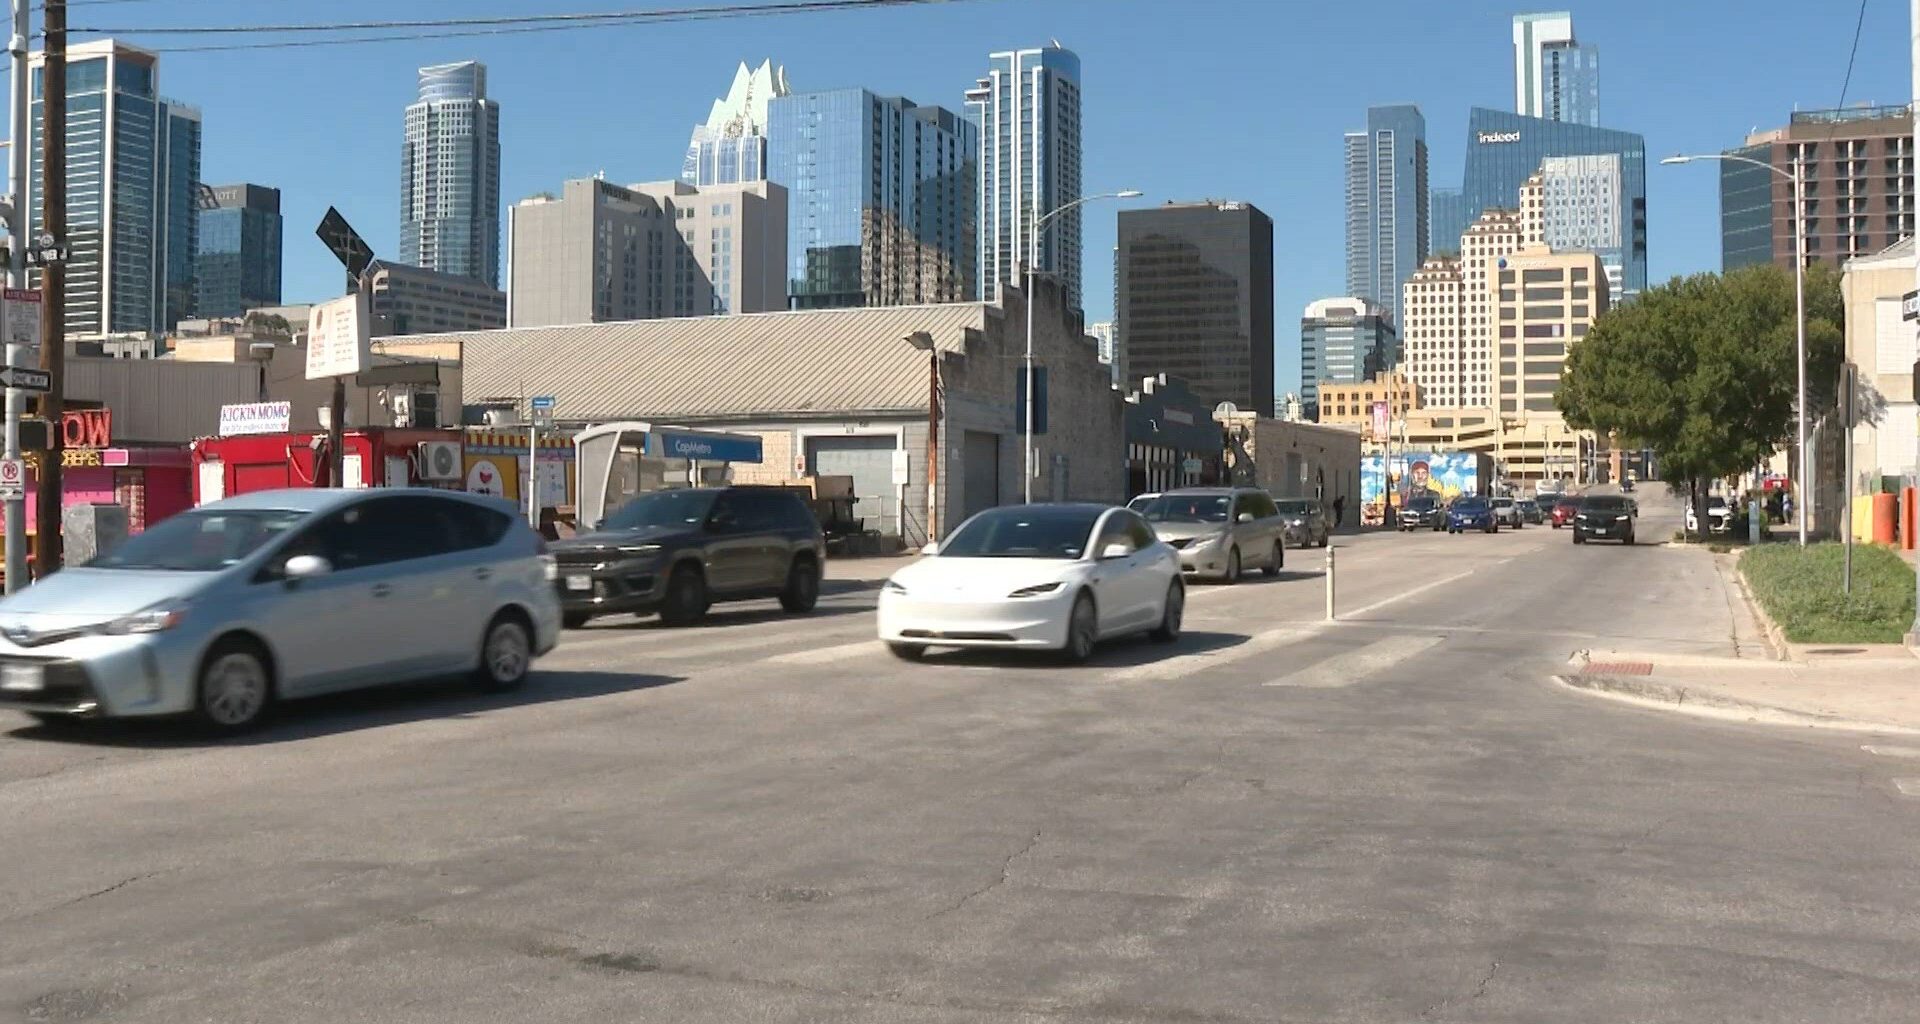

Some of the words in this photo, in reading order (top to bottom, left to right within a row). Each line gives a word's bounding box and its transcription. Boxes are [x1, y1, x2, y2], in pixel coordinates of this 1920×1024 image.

[1478, 130, 1520, 144] indeed
[222, 406, 257, 421] KICKIN
[259, 405, 289, 419] MOMO
[62, 410, 112, 448] OW
[675, 440, 712, 454] CapMetro
